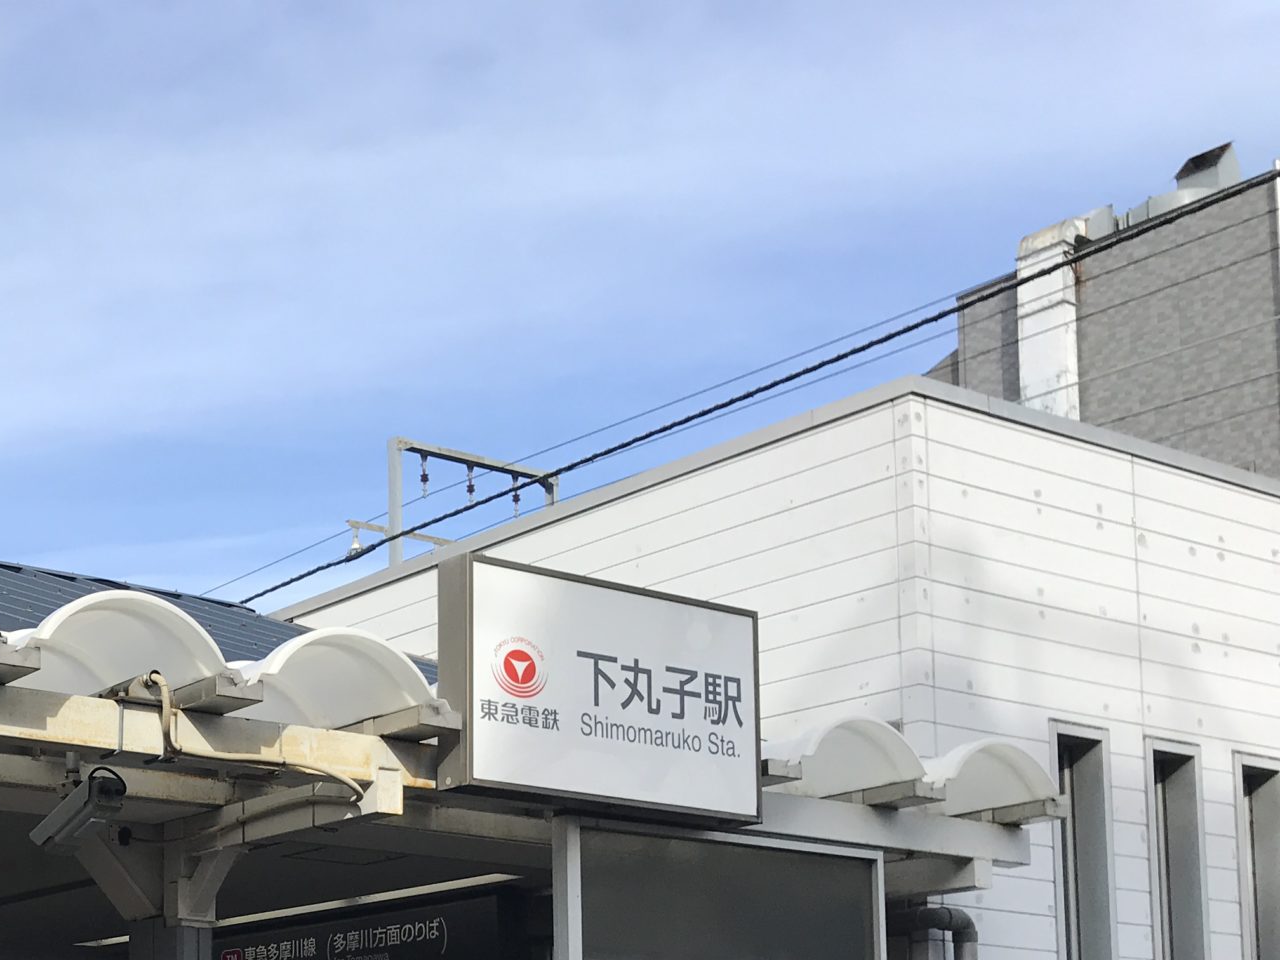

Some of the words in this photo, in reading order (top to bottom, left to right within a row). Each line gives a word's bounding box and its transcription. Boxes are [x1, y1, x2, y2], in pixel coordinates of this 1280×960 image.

[576, 649, 744, 729] 下丸子駅
[479, 698, 560, 732] 東急電鉄
[580, 714, 702, 753] Shimomaruko
[707, 731, 741, 758] Sta.
